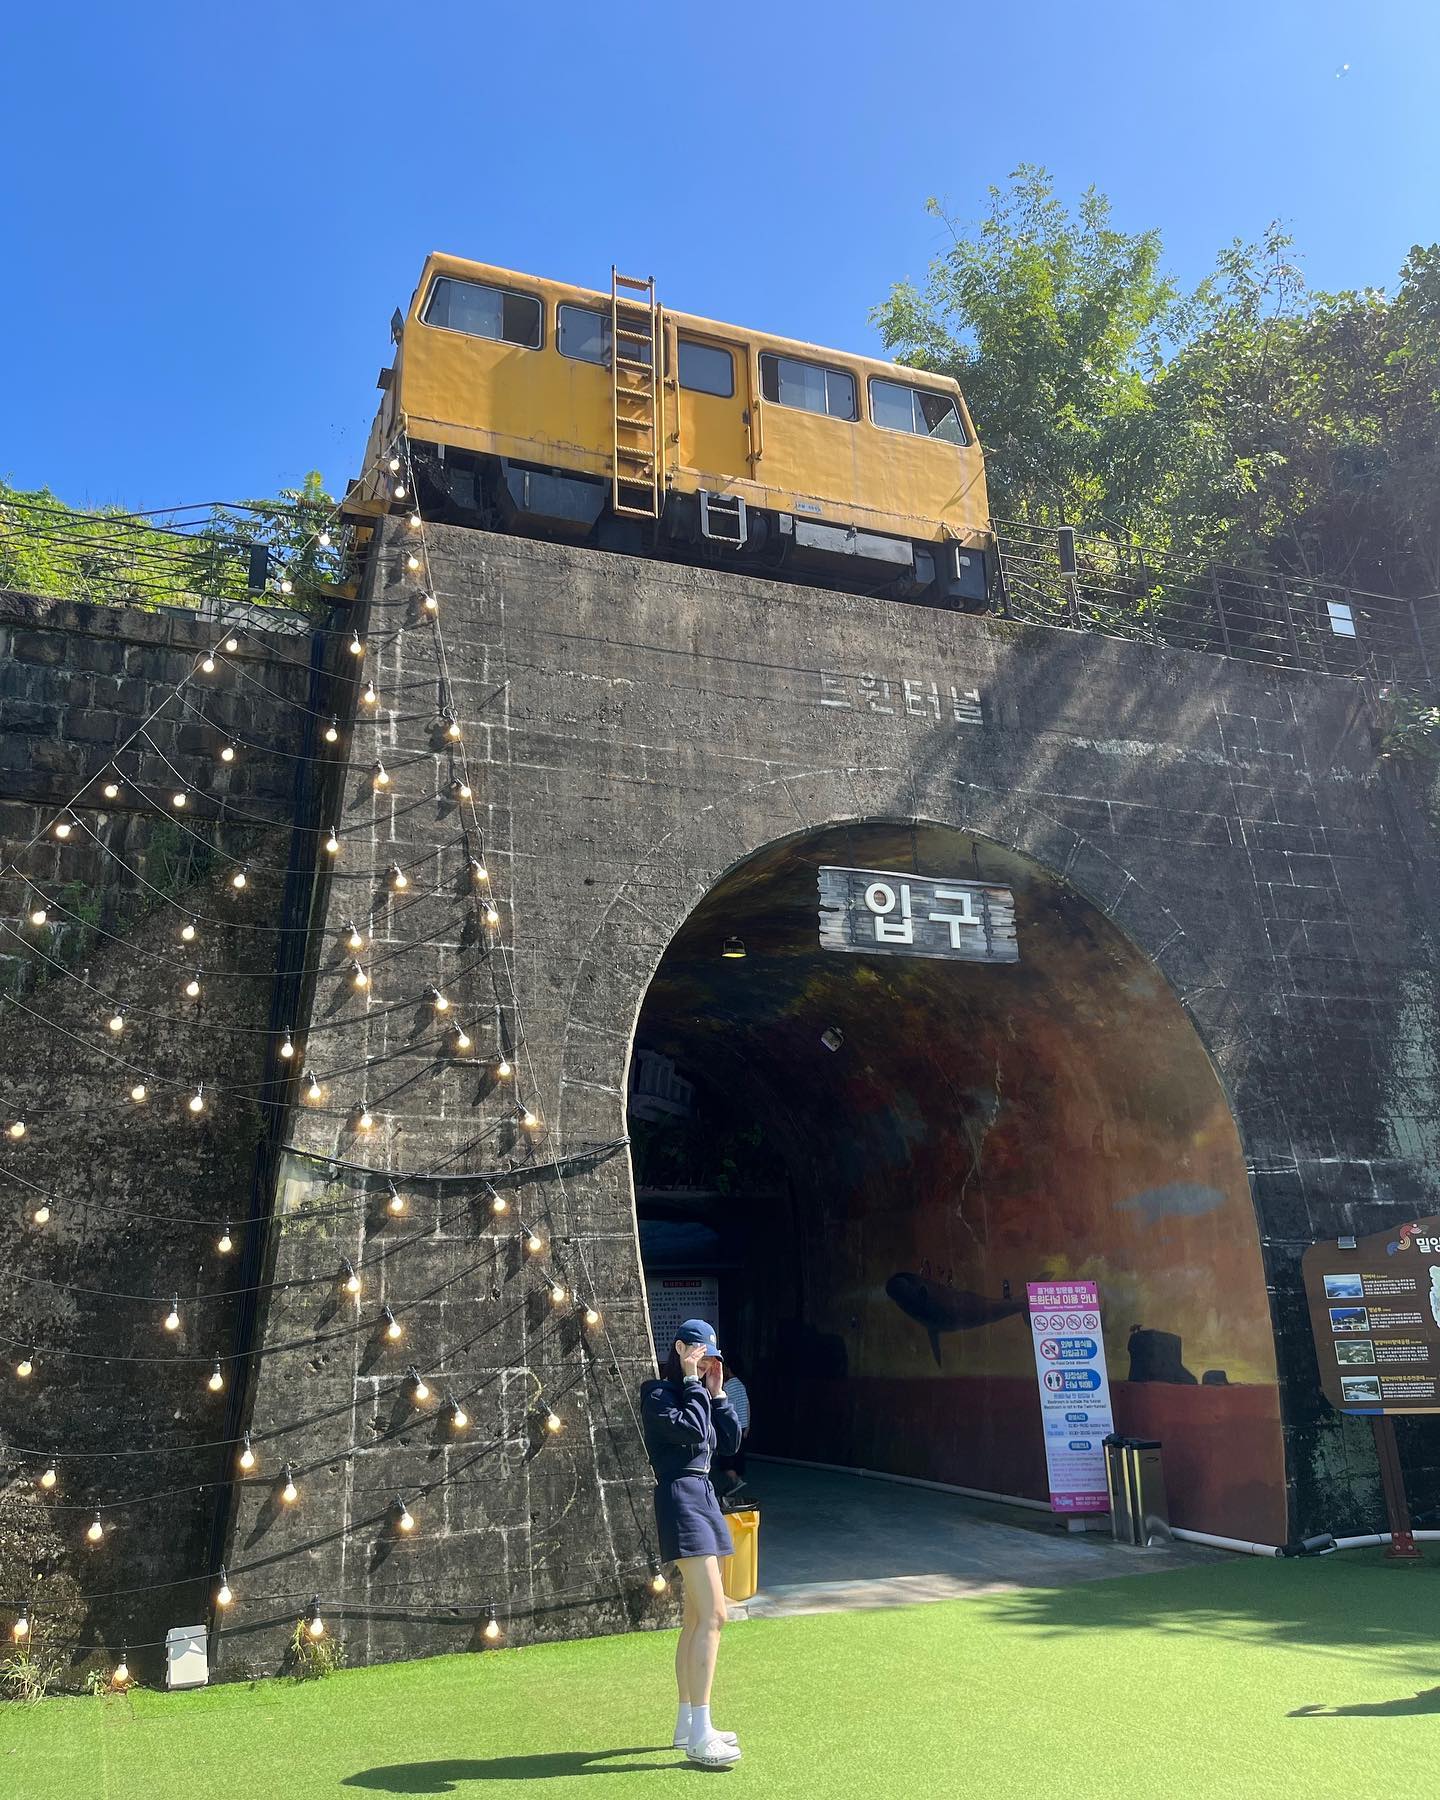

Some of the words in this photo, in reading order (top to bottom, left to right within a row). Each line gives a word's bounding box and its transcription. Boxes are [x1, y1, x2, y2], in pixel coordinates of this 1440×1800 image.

[820, 668, 984, 725] 트윈터널
[865, 882, 980, 949] 입구
[1029, 1295, 1061, 1305] 트윈터널
[1062, 1294, 1078, 1304] 이용
[1080, 1293, 1097, 1304] 안내
